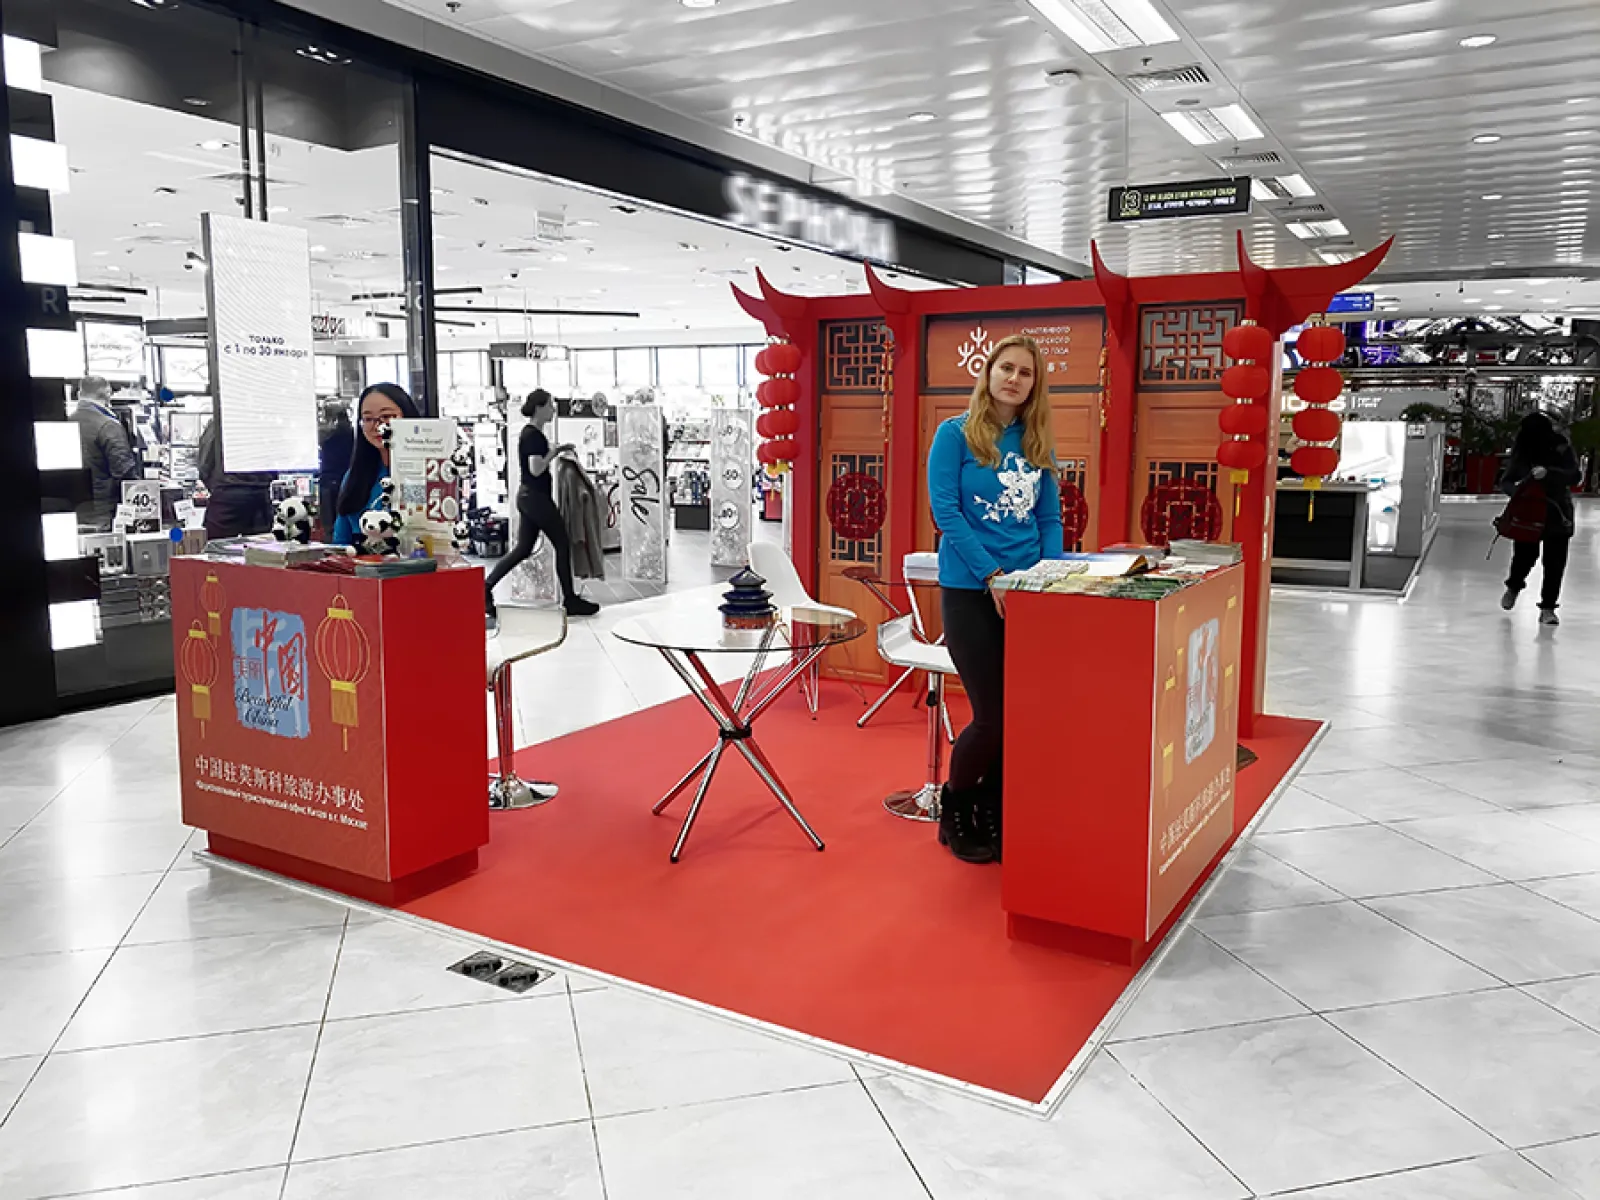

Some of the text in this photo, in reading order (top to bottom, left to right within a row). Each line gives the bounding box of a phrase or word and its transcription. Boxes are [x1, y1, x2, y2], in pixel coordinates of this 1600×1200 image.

[259, 344, 272, 356] 30
[622, 465, 660, 526] Sale
[235, 687, 293, 715] Beautiful
[244, 708, 280, 728] China
